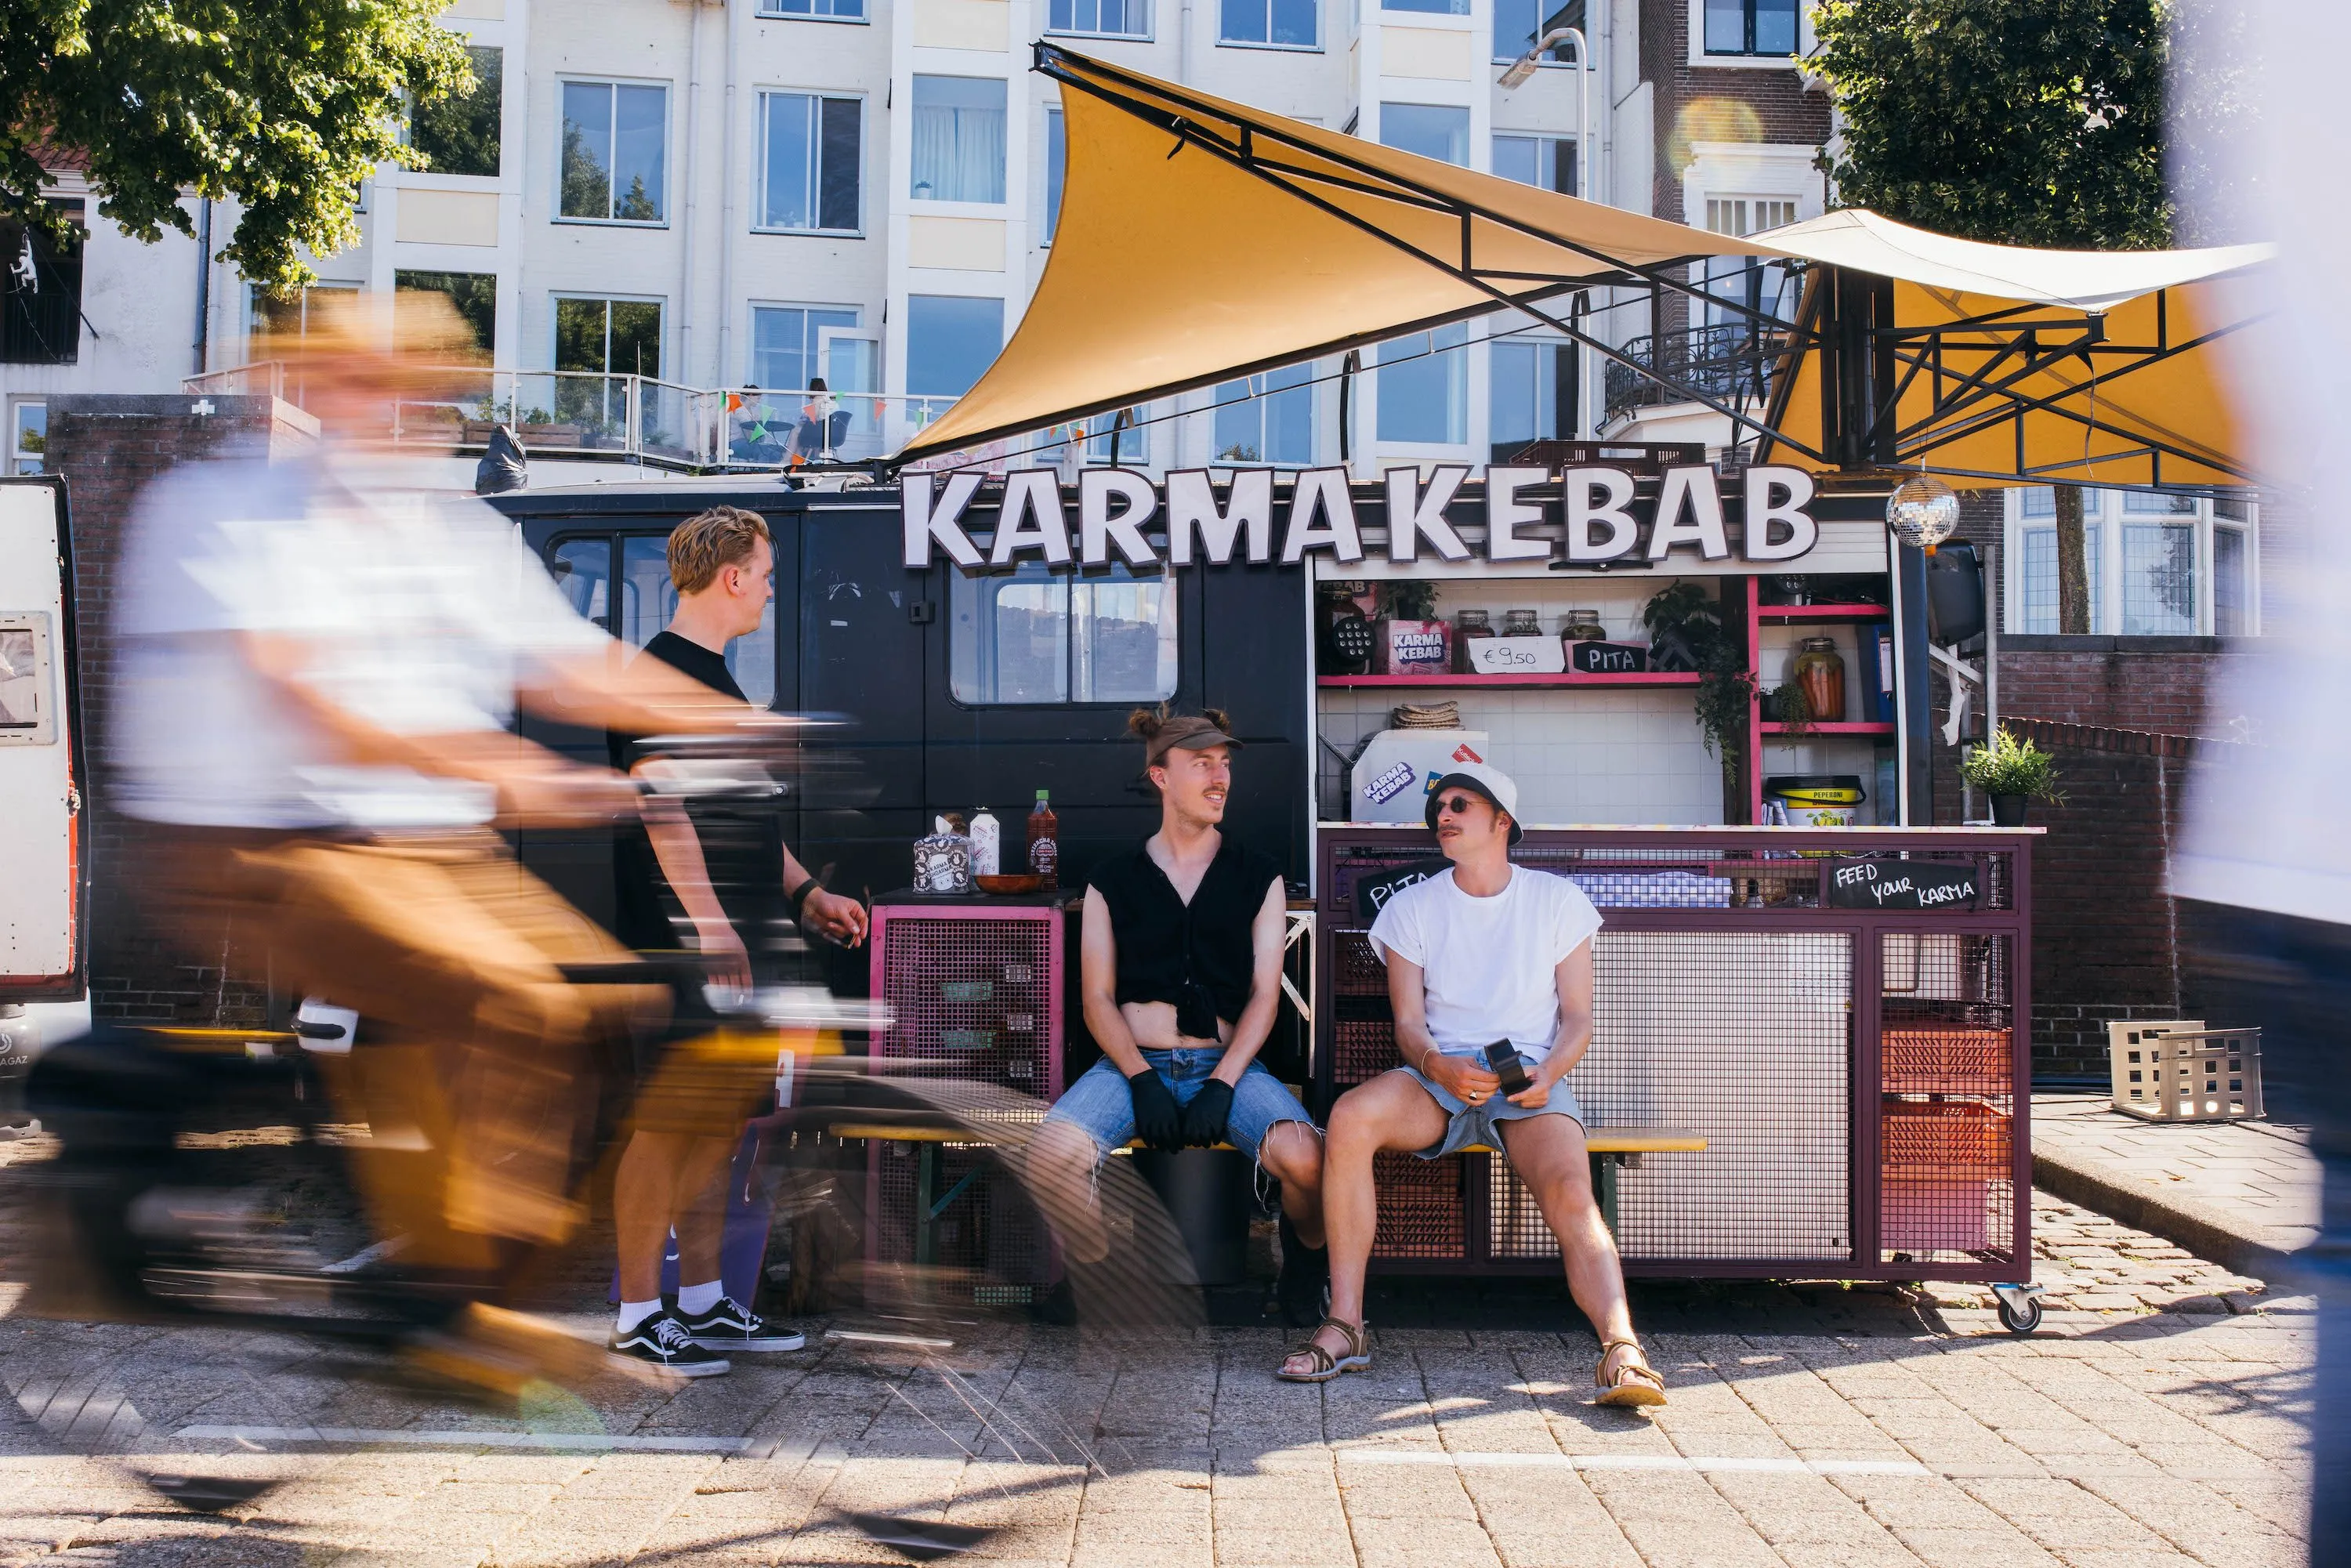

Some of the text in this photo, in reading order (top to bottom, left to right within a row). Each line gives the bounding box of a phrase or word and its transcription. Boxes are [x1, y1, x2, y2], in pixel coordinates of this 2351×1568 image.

[1393, 634, 1444, 648] KARMA
[1398, 646, 1442, 660] KEBAB
[1588, 649, 1636, 669] PITA
[1363, 762, 1408, 798] KARMA
[1371, 772, 1411, 803] KEBAB
[1031, 838, 1051, 856] SRIRACHA
[929, 861, 947, 871] KARMA
[1836, 864, 1976, 907] FEED YOUR KARMA
